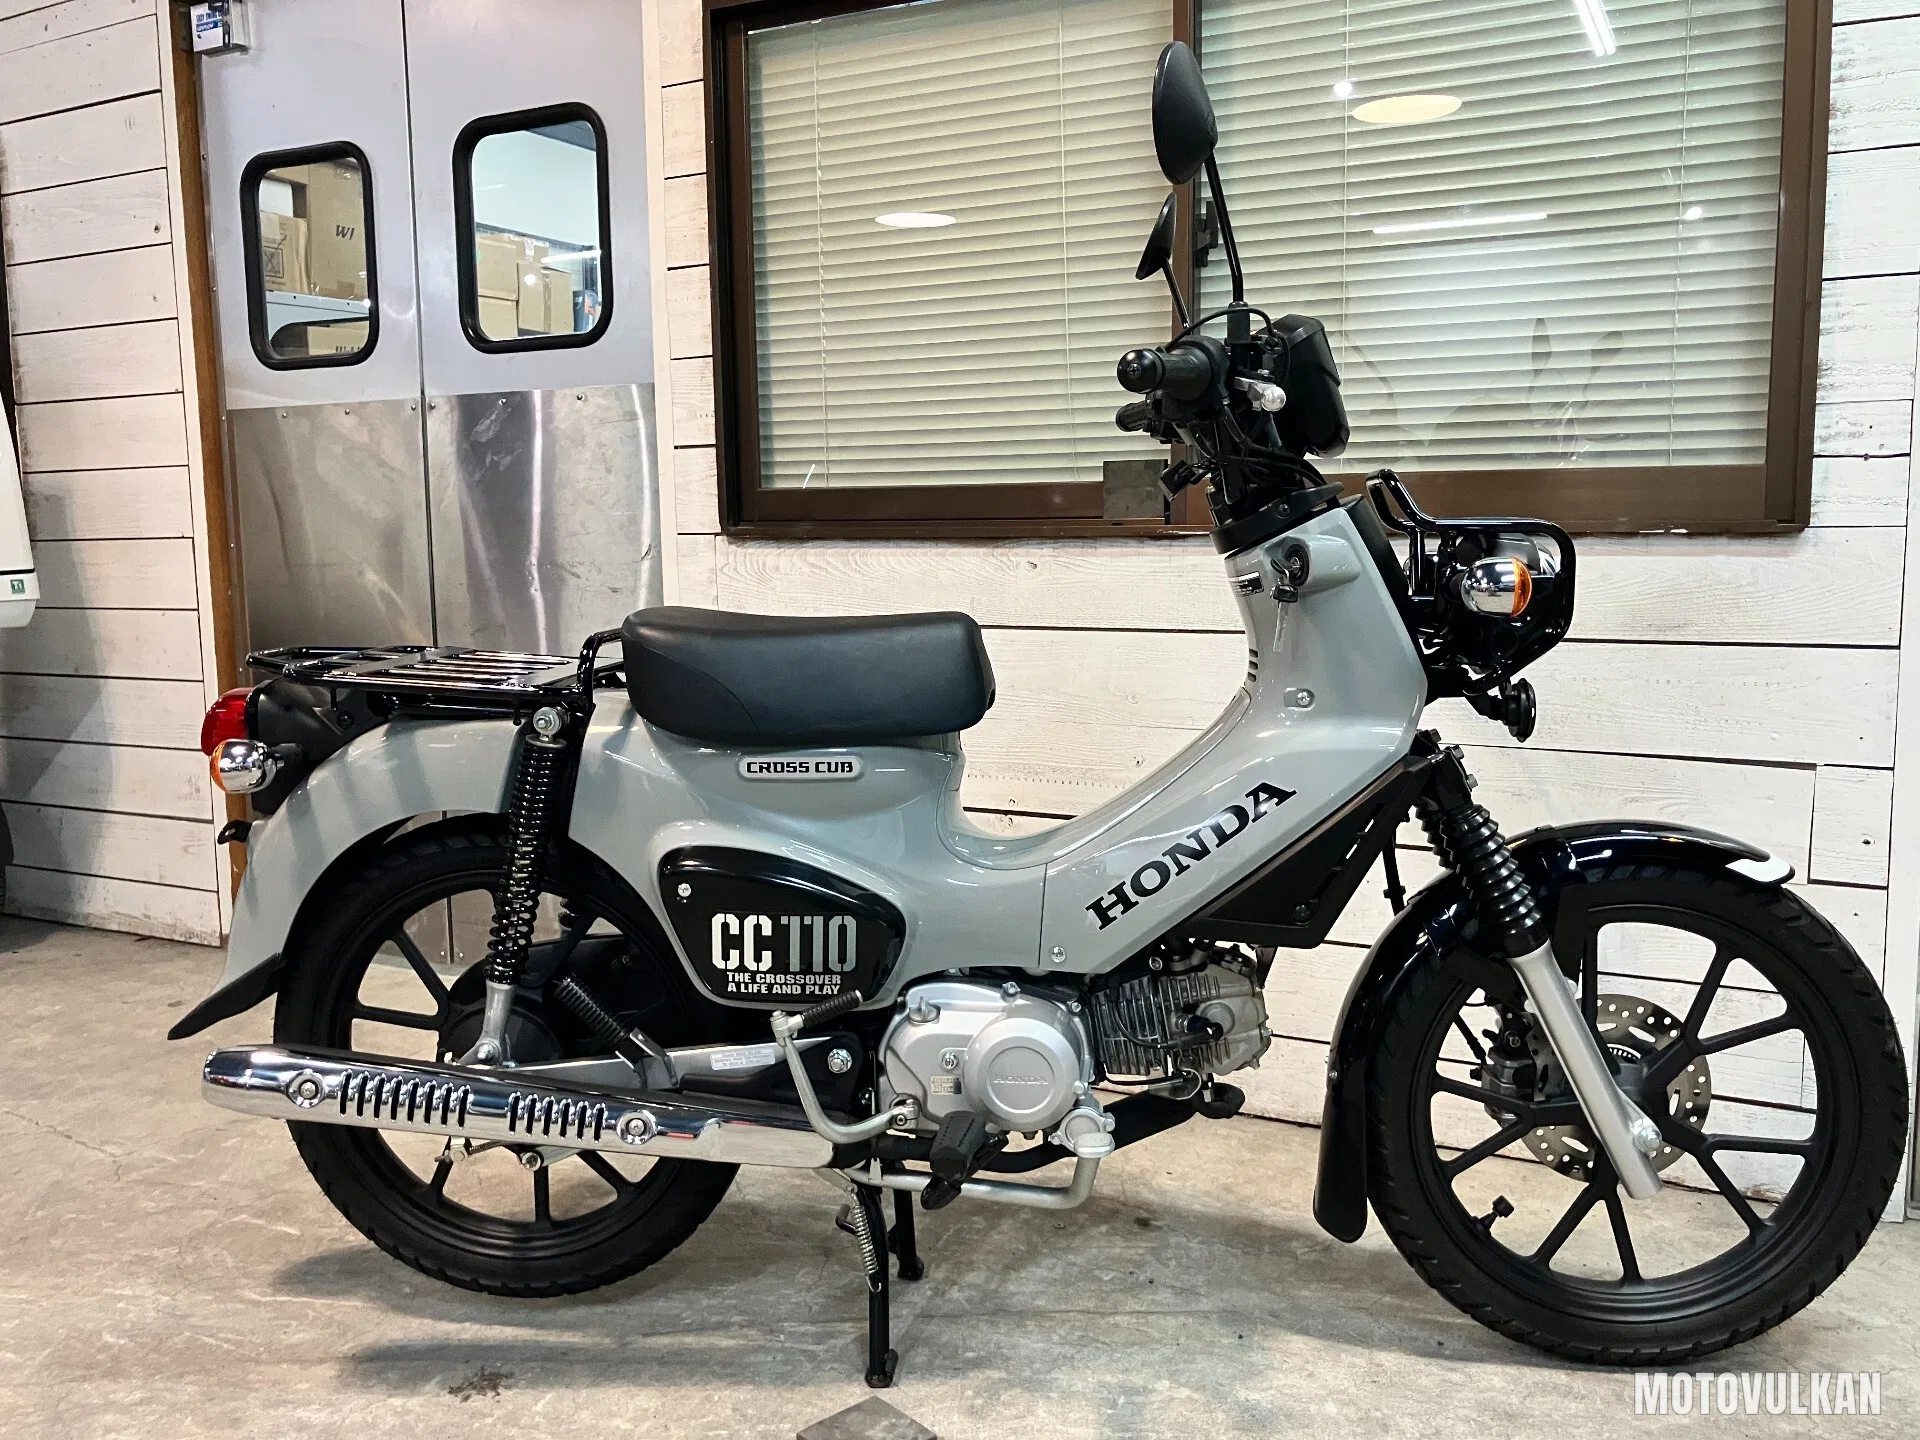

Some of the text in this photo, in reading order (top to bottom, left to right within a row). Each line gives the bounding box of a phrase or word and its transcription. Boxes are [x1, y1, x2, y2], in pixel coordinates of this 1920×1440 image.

[746, 761, 854, 773] CROSS CUB
[1085, 781, 1297, 931] HONDA
[726, 971, 842, 985] THE CROSSOVER
[727, 982, 841, 995] A LIFE AND PLAY
[992, 1075, 1049, 1085] HONDA
